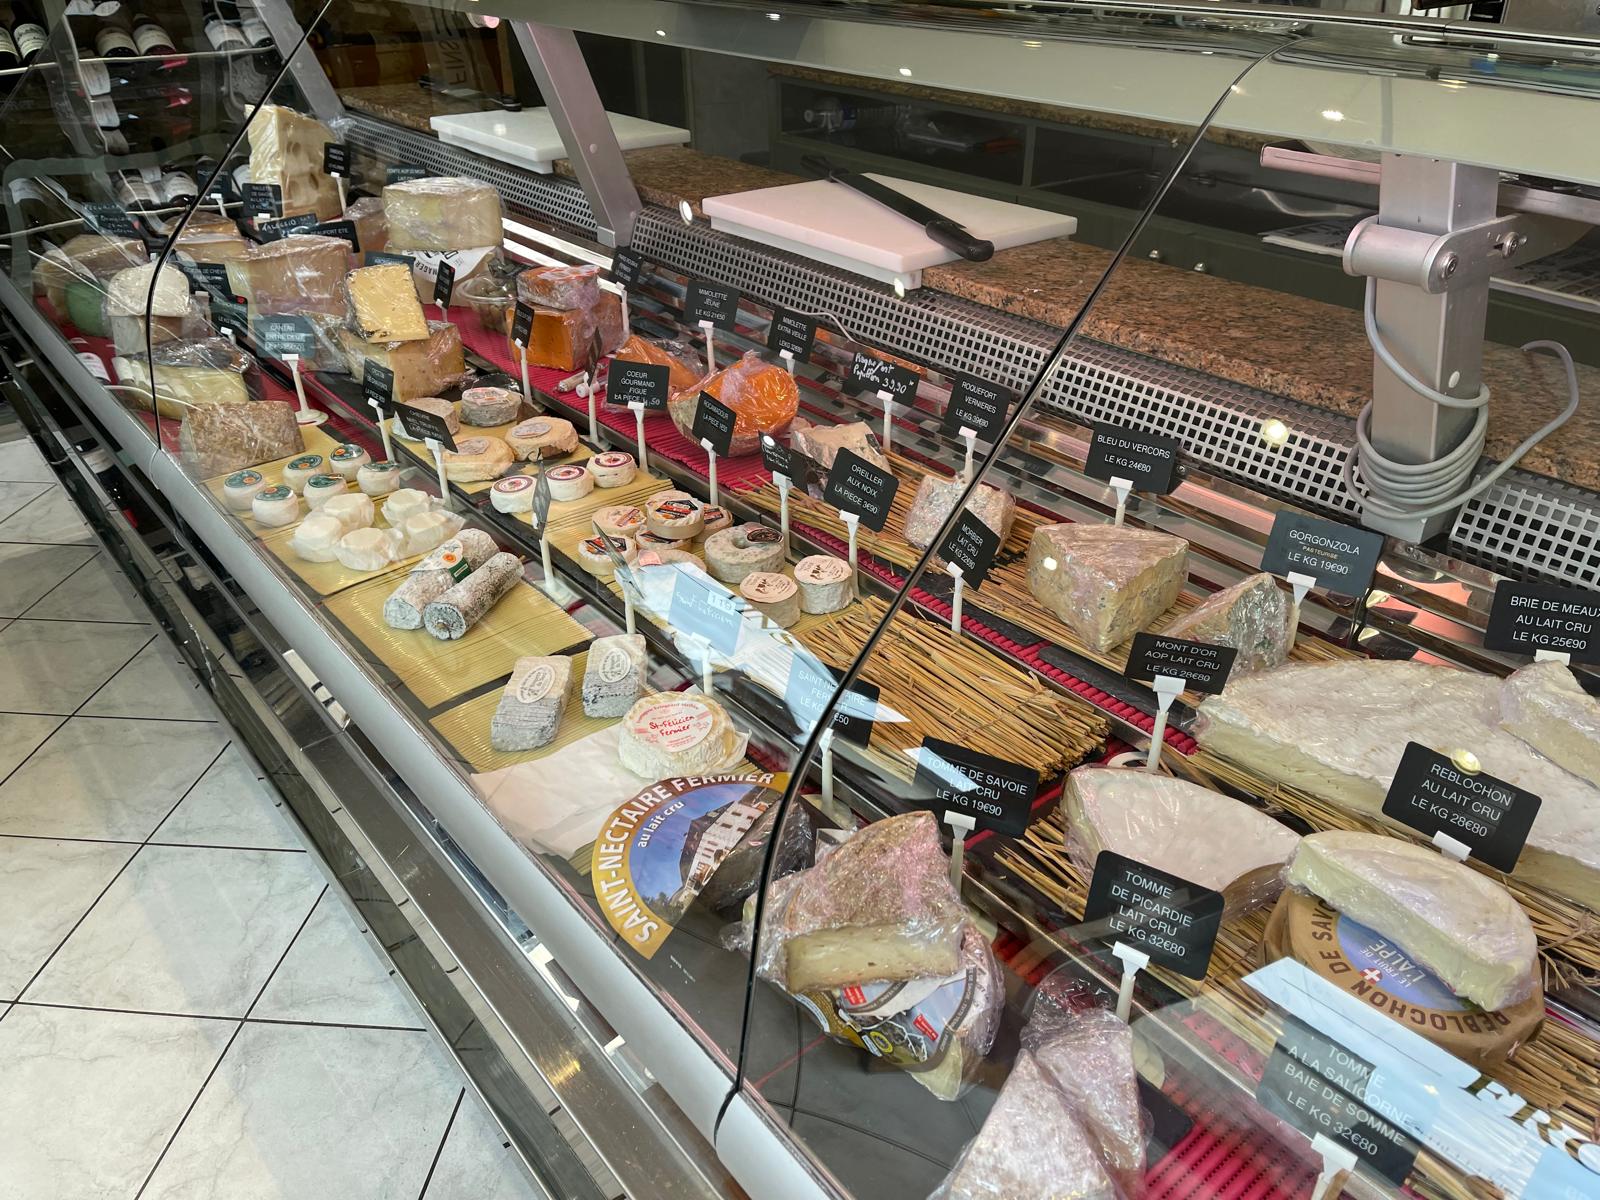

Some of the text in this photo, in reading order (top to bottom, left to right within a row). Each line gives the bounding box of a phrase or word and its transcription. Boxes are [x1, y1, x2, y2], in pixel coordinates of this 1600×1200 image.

[699, 288, 728, 301] MIMOLETTE
[704, 298, 720, 309] JEUNE
[620, 377, 656, 388] GOURMAND
[626, 370, 648, 379] COEUR
[628, 387, 648, 395] FIGUE
[961, 381, 997, 401] ROQUEFORT
[955, 408, 964, 417] LE
[964, 395, 997, 414] VERNIERES
[1097, 434, 1171, 459] BLEU DU VERCORS
[1104, 454, 1115, 464] LE
[1115, 457, 1128, 467] KG
[847, 475, 878, 498] AUX NOIX
[851, 464, 883, 487] OREILLER
[834, 484, 843, 495] LA
[843, 489, 863, 505] PIECE
[957, 535, 979, 557] LAIT CRU
[961, 523, 984, 547] MORBIER
[1289, 529, 1360, 556] GORGONZOLA
[948, 541, 957, 552] LE
[954, 547, 963, 558] KG
[1287, 551, 1349, 575] LE KG 19€90
[1510, 595, 1540, 609] BRIE
[1541, 600, 1560, 612] DE
[1515, 614, 1592, 634] AU LAIT CRU
[1155, 640, 1218, 658] MONT D'OR
[1512, 630, 1587, 650] LE KG 25€90
[1145, 650, 1220, 670] AOP LAIT CRU
[1146, 664, 1161, 672] LE
[1162, 666, 1178, 676] KG
[927, 756, 1029, 796] TOMME DE SAVOIE
[1430, 762, 1512, 807] REBLOCHON
[935, 788, 1003, 817] LE KG 19€90
[975, 785, 1001, 801] CRU
[1421, 779, 1501, 821] AU LAIT CRU
[637, 800, 686, 848] au lait cru
[1411, 794, 1488, 838] LE KG 28€80
[598, 772, 776, 943] SAINT-NECTAIRE FERMIER
[1125, 870, 1173, 899] TOMME
[1111, 884, 1193, 928] DE PICARDIE
[1119, 904, 1178, 937] LAIT CRU
[1109, 917, 1186, 957] LE KG 32€80
[1320, 949, 1353, 975] DE
[1370, 938, 1427, 984] L'ALPE
[1328, 1043, 1387, 1090] TOMME
[1287, 1045, 1415, 1127] A LA SALICORNE
[1284, 1062, 1407, 1146] BAIE DE SOMME
[1286, 1090, 1379, 1156] LE KG 32€80
